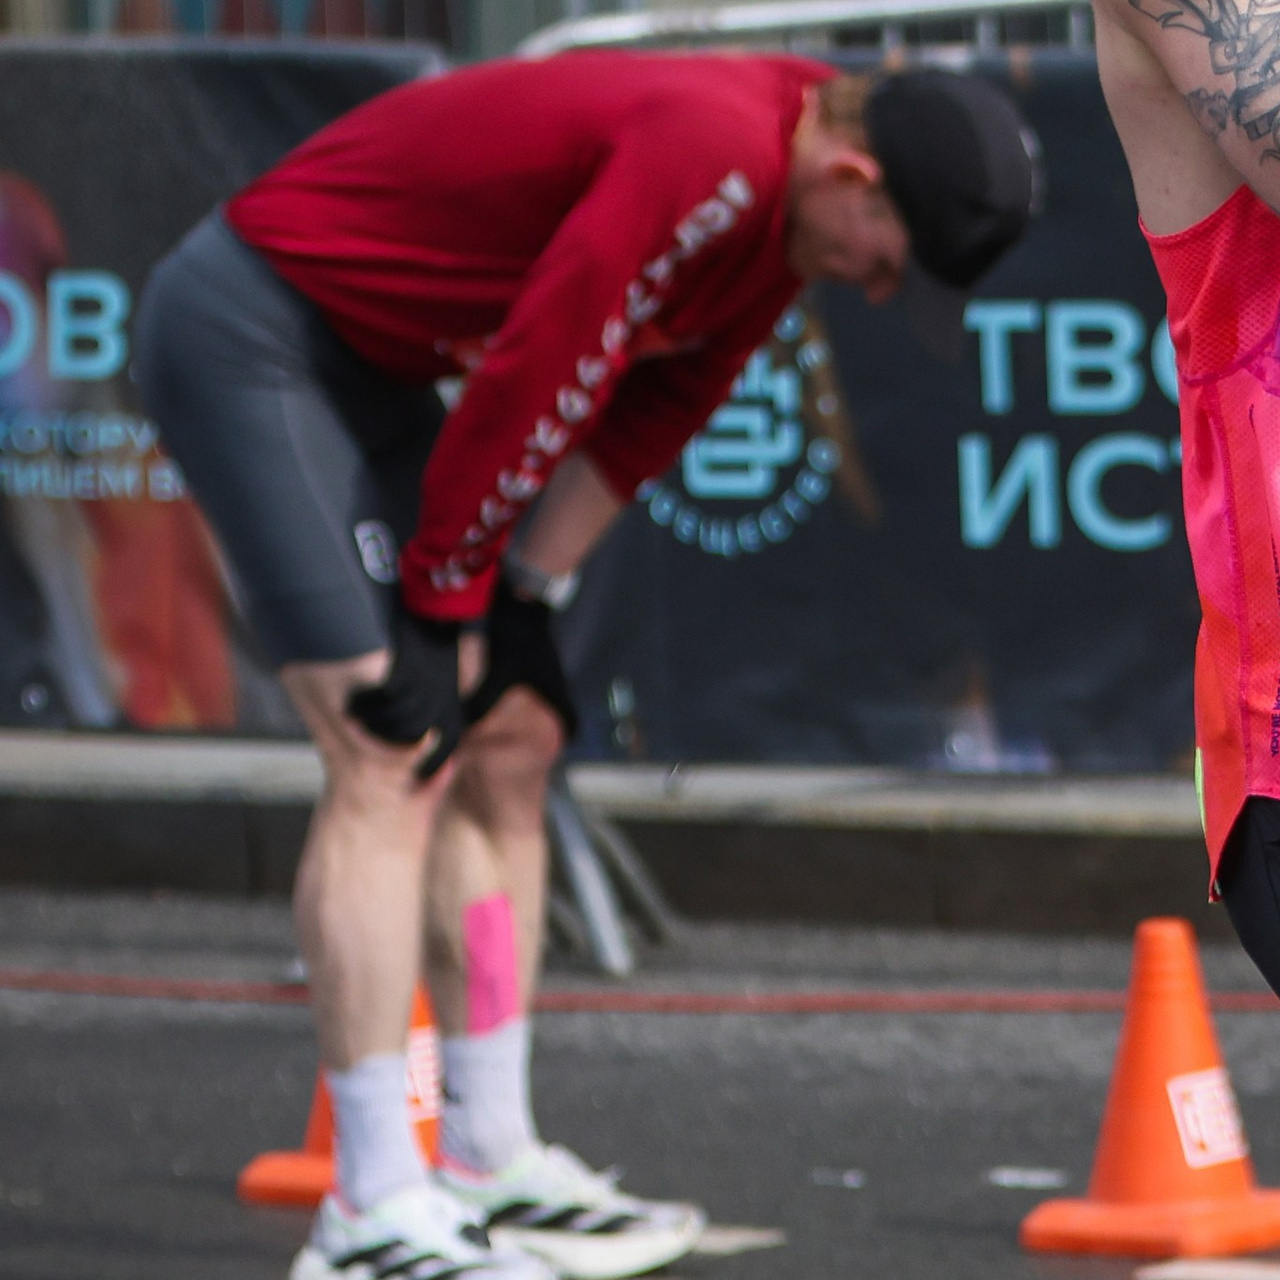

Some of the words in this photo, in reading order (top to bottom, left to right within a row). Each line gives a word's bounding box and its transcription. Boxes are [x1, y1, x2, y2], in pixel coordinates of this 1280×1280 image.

[962, 298, 1177, 416] ТВ
[956, 432, 1181, 553] ИС
[1269, 712, 1280, 757] YOU'RE
